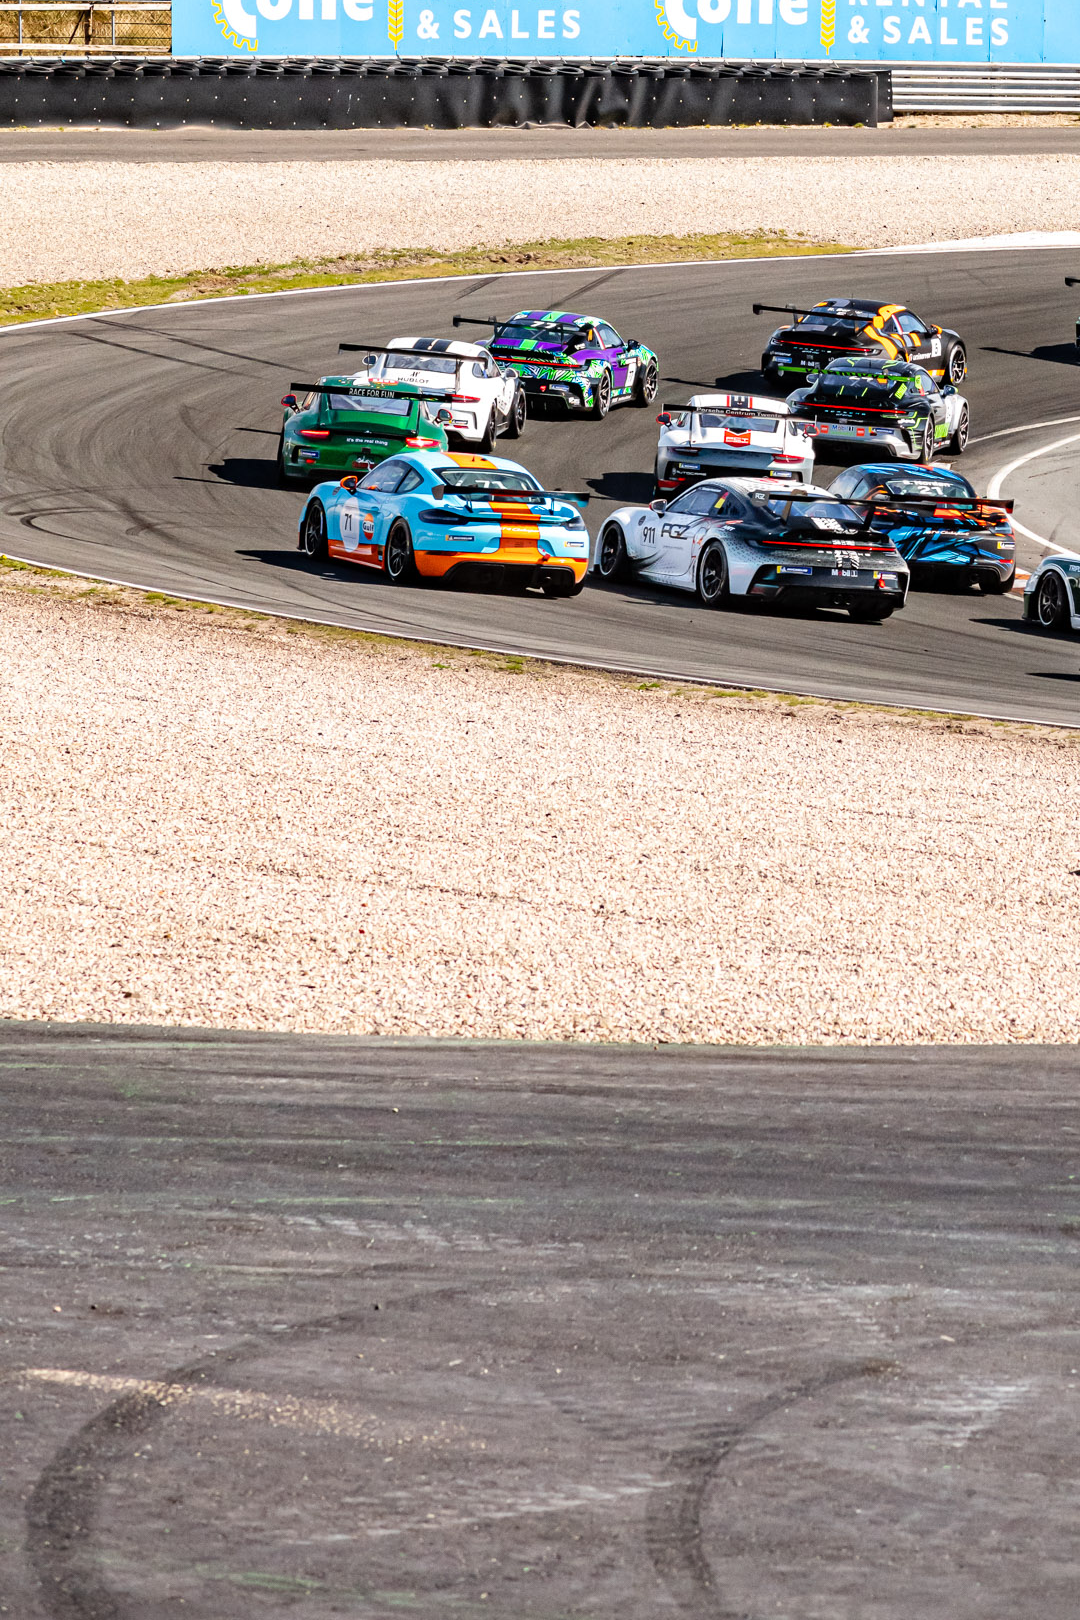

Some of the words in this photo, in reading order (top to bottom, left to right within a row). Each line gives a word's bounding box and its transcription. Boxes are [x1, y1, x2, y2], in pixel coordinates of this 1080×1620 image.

[416, 9, 440, 40] &
[453, 9, 581, 40] SALES
[847, 15, 870, 44] &
[883, 15, 1009, 47] SALES
[348, 387, 365, 396] RACE
[366, 389, 380, 398] FOR
[344, 513, 353, 531] 71
[362, 522, 375, 532] Gulf
[642, 526, 656, 544] 911
